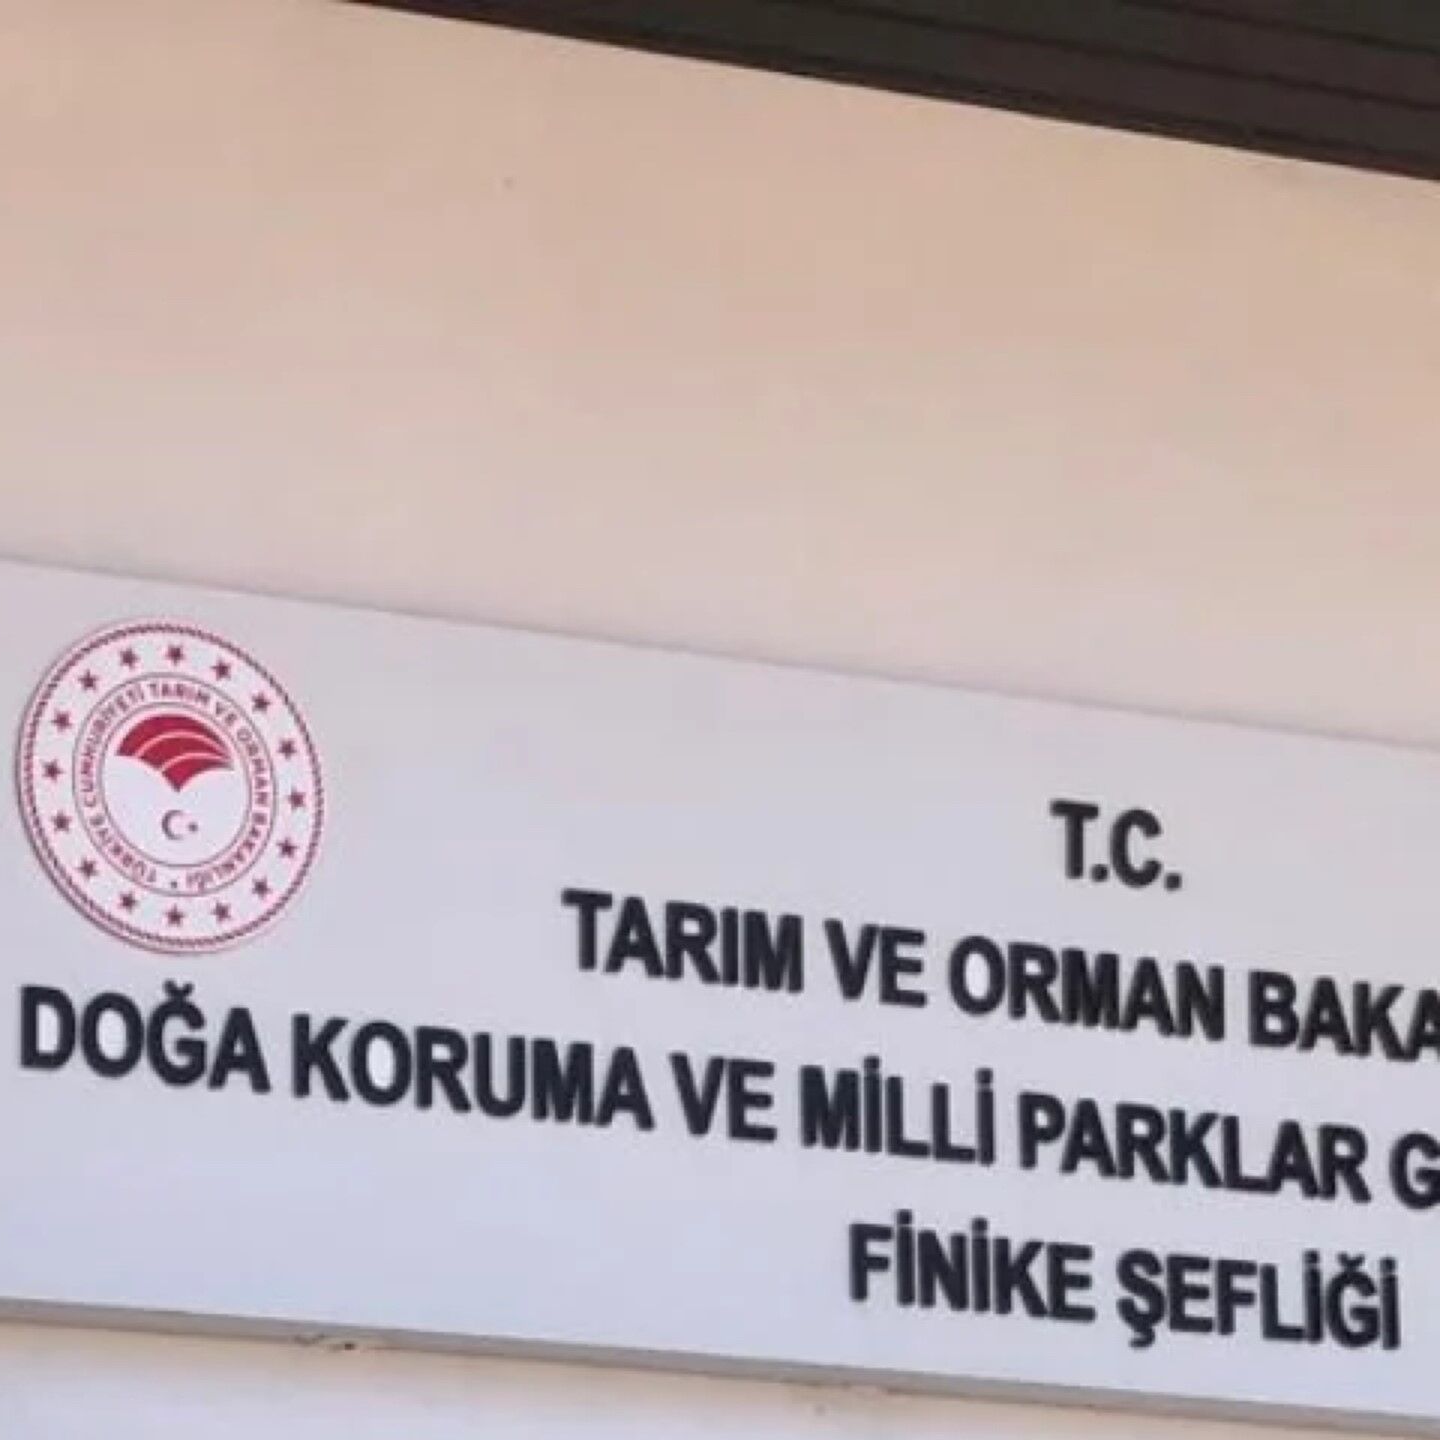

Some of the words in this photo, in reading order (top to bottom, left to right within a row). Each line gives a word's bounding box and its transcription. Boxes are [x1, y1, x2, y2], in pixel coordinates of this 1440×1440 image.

[148, 681, 211, 706] TARIM
[214, 701, 238, 726] VE
[236, 726, 270, 806] ORMAN
[1050, 799, 1183, 891] T.C.
[561, 887, 805, 994] TARIM
[823, 918, 928, 1009] VE
[948, 934, 1226, 1043] ORMAN
[1248, 969, 1440, 1063] BAKA
[19, 979, 272, 1094] DOĞA
[292, 1012, 656, 1132] KORUMA
[669, 1052, 778, 1143] VE
[799, 1055, 996, 1167] MİLLİ
[1018, 1090, 1373, 1204] PARKLAR
[1388, 1132, 1440, 1211] G
[848, 1208, 1097, 1324] FİNİKE
[1115, 1248, 1401, 1351] ŞEFLİĞİ
